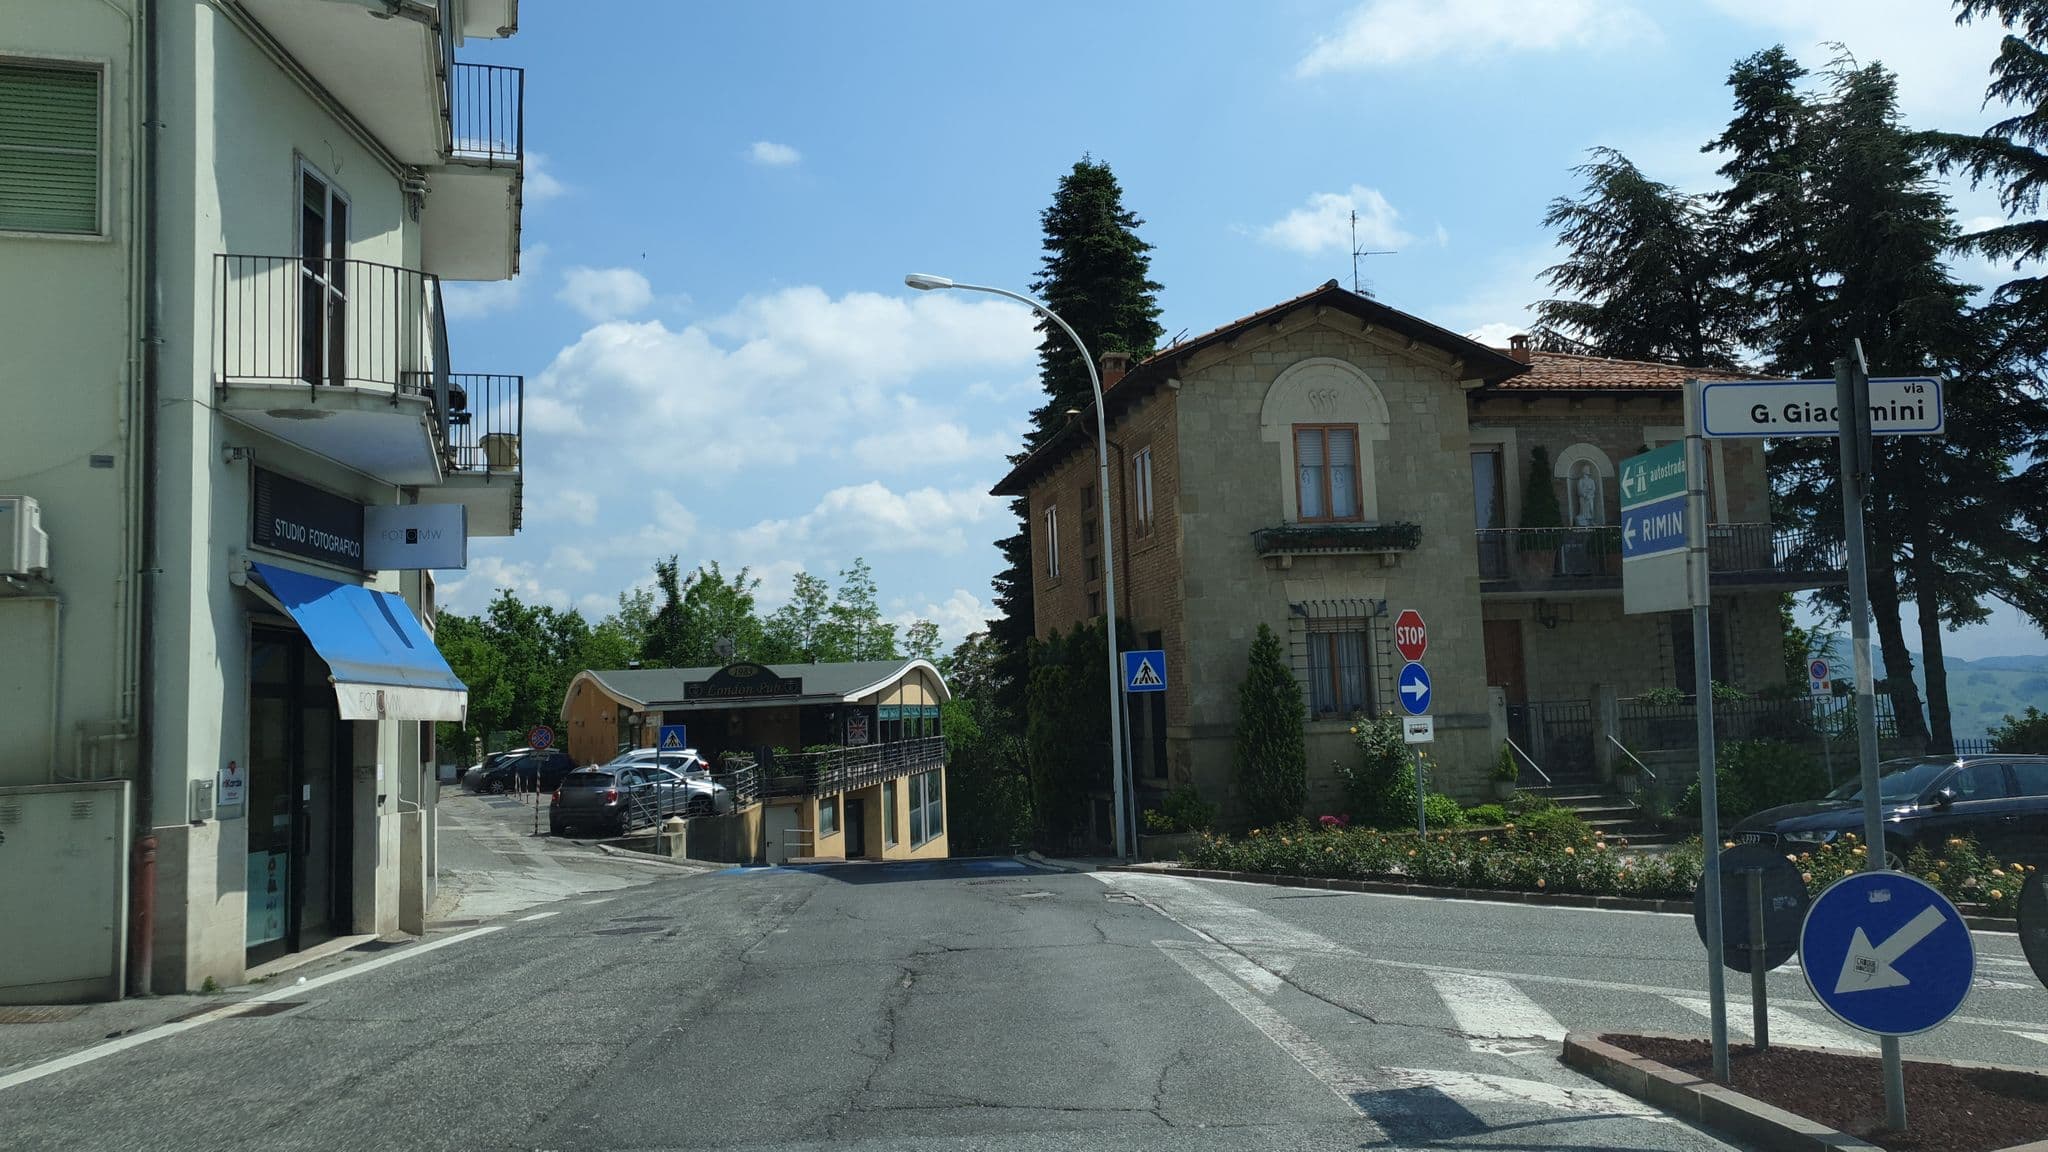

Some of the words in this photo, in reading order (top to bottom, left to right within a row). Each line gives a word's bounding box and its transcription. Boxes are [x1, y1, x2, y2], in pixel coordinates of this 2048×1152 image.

[1903, 383, 1925, 394] via
[1750, 403, 1777, 424] G.
[1783, 400, 1925, 423] Giacmini
[1650, 457, 1686, 482] autostrada
[274, 518, 306, 544] STUDIO
[309, 528, 360, 558] FOTOGRAFICO
[1643, 511, 1684, 542] RIMIN
[1397, 626, 1424, 645] STOP
[706, 683, 753, 696] London
[758, 682, 781, 695] Pub
